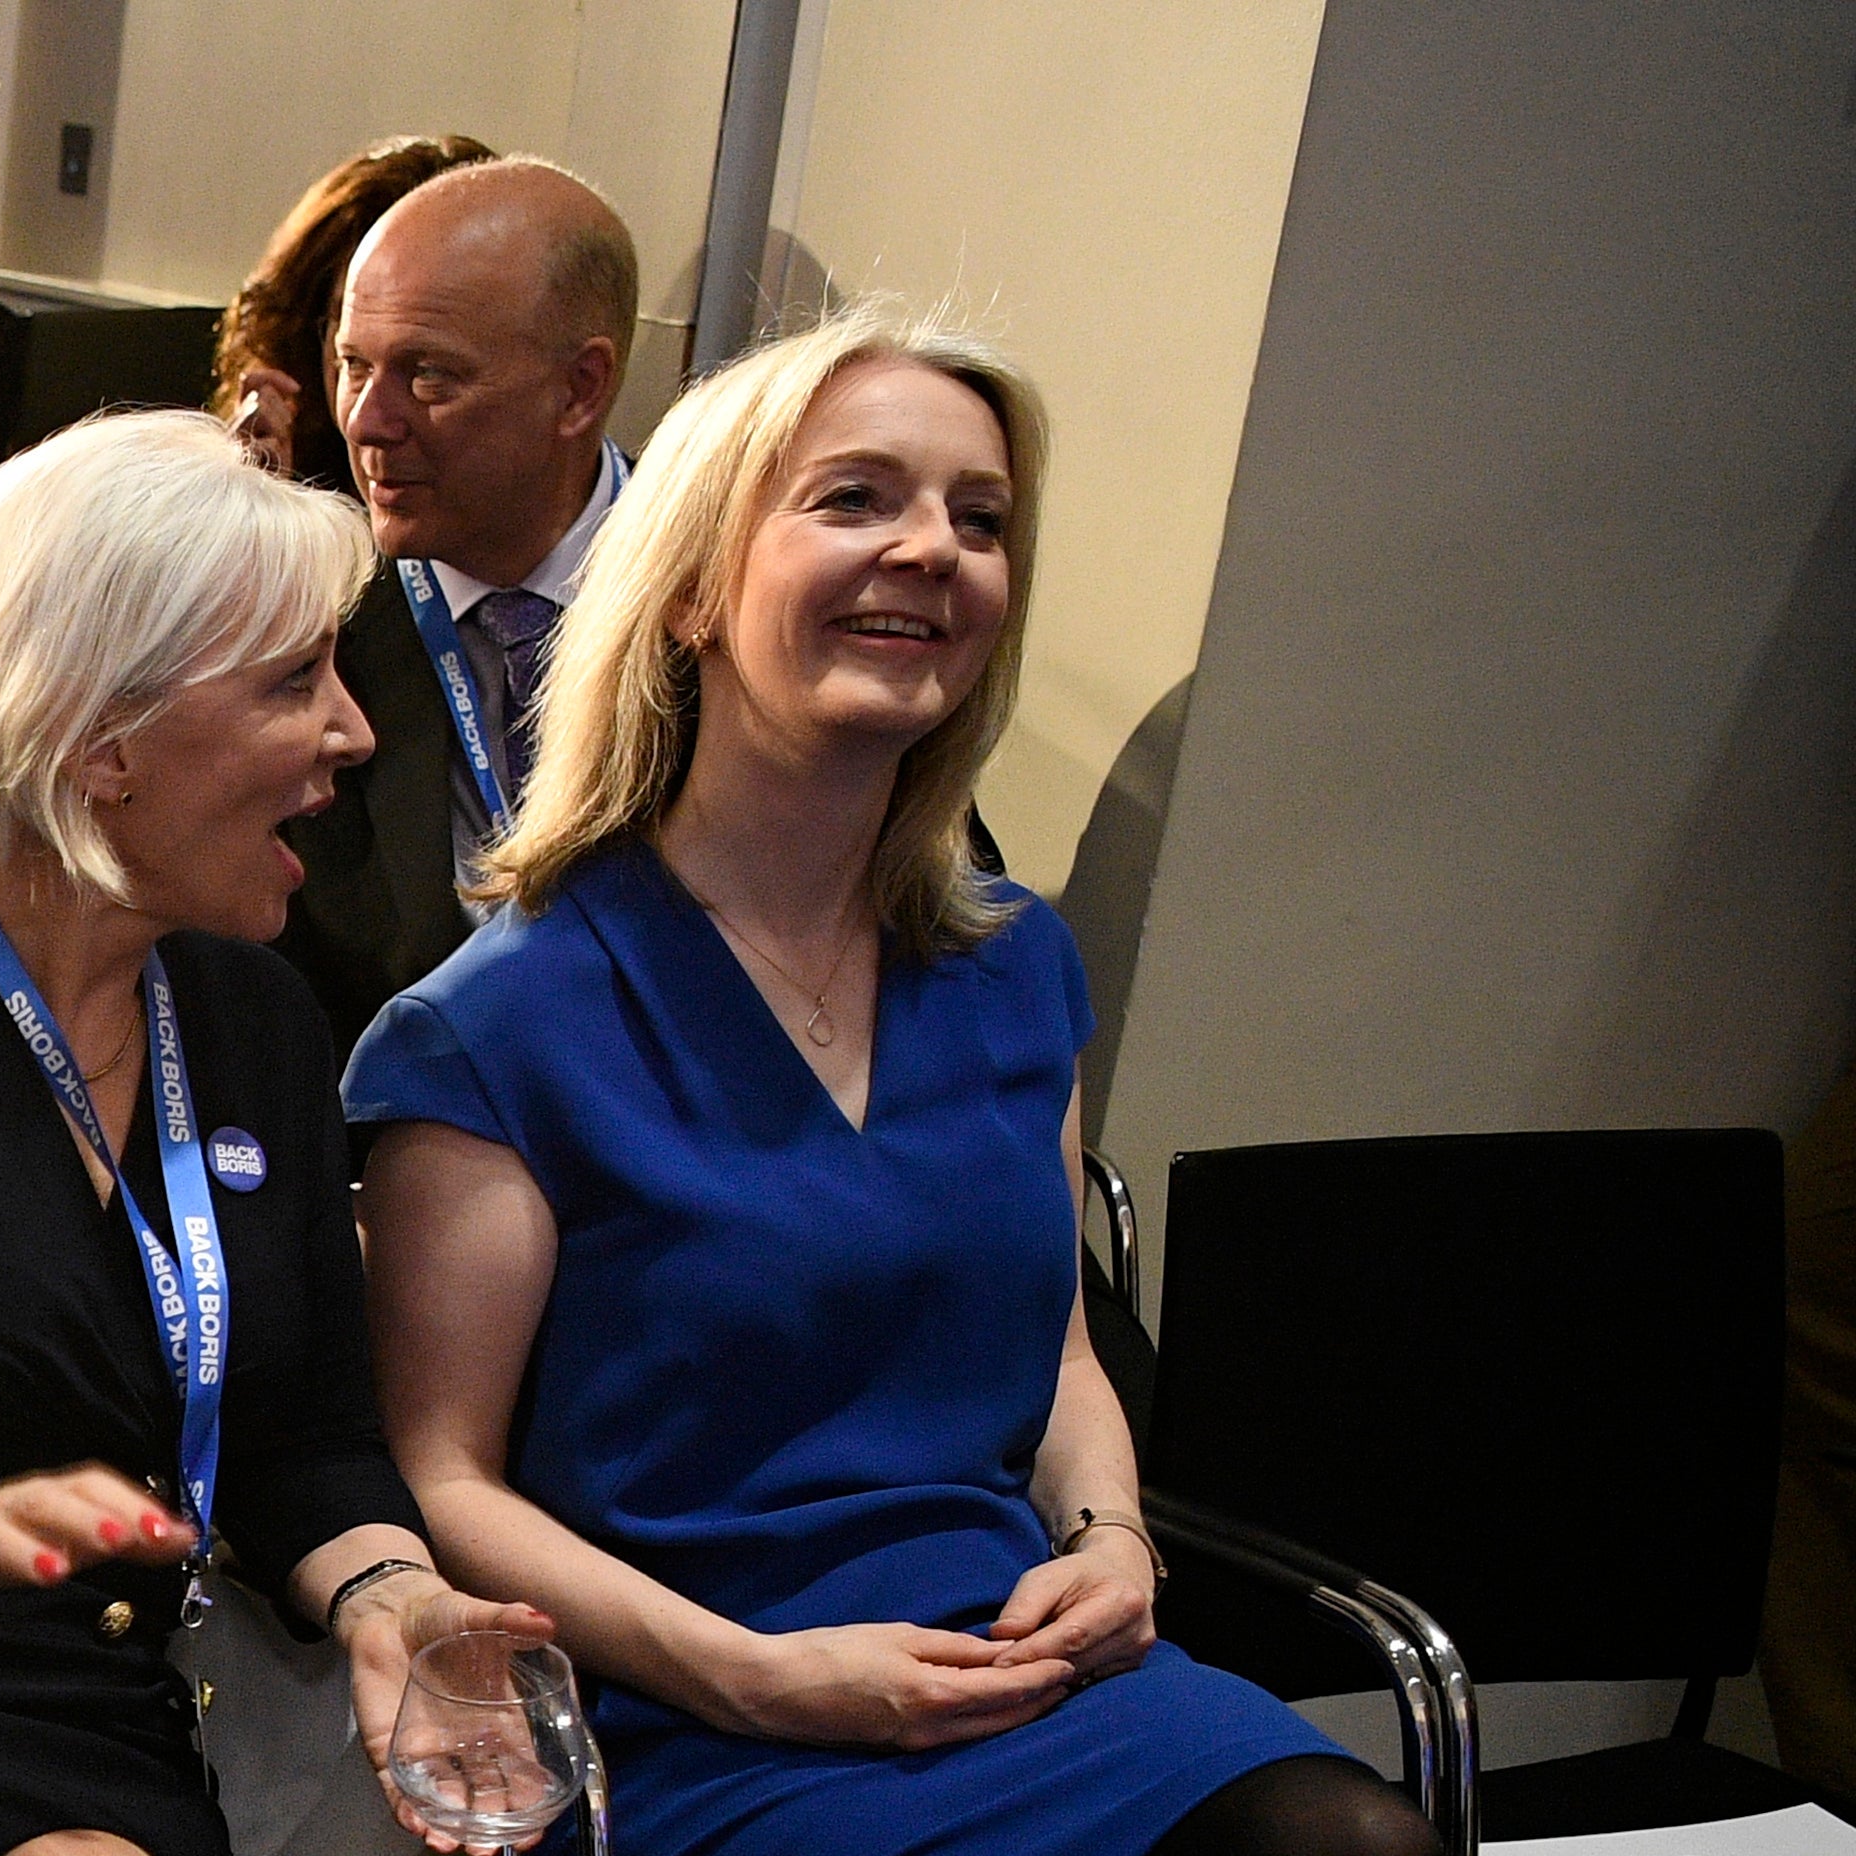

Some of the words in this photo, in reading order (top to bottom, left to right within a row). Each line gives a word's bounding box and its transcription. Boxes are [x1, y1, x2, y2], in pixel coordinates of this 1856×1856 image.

[439, 651, 473, 712] BORIS
[458, 709, 489, 771] BACK
[4, 990, 67, 1074] BORIS
[153, 982, 178, 1060] BACK
[160, 1060, 191, 1143] BORIS
[214, 1143, 260, 1162] BACK
[216, 1158, 263, 1176] BORIS
[141, 1230, 186, 1319] BORIS
[184, 1216, 219, 1291] BACK
[198, 1293, 222, 1386] BORIS
